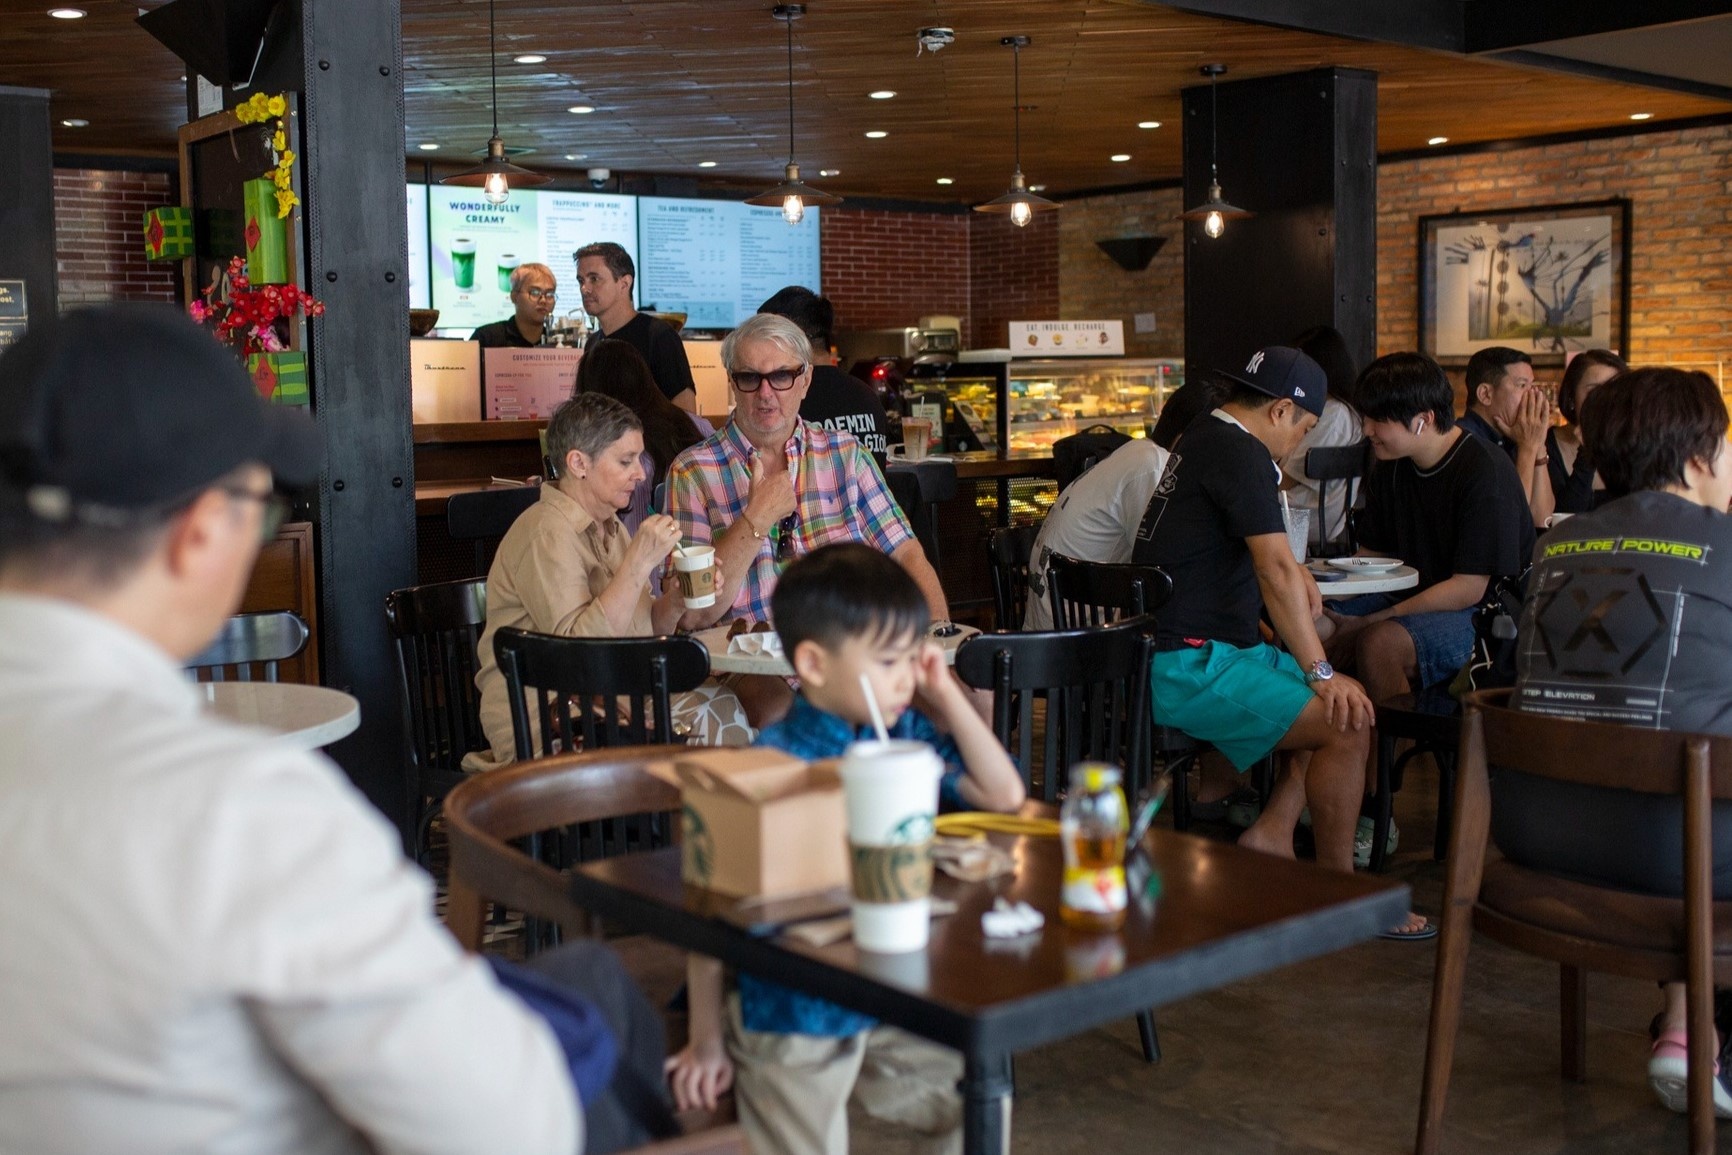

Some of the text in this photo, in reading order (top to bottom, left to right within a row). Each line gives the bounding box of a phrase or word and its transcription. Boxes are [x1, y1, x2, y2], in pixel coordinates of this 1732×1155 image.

[449, 202, 520, 213] WONDERFULLY
[465, 214, 505, 224] CREAMY
[813, 413, 876, 433] AEMIN
[1544, 539, 1703, 560] NATURE POWER
